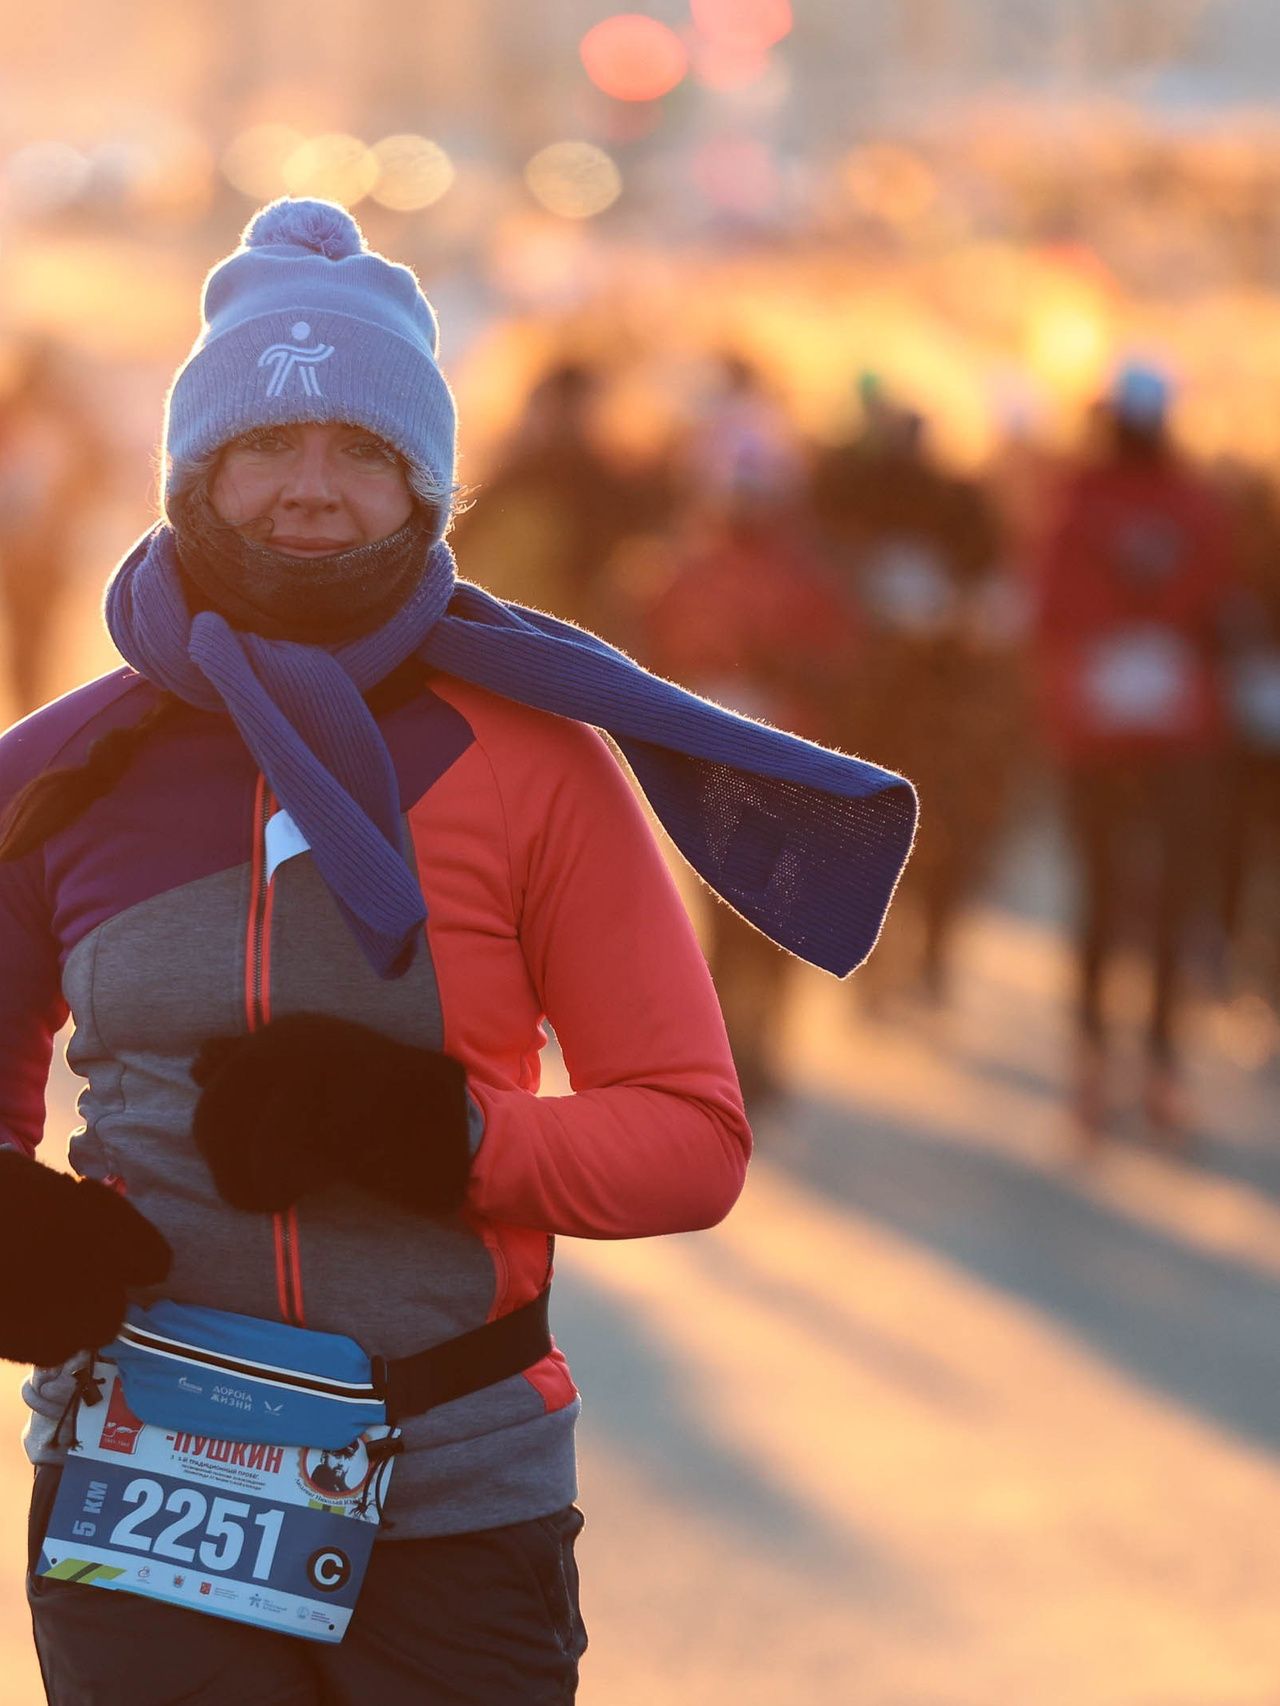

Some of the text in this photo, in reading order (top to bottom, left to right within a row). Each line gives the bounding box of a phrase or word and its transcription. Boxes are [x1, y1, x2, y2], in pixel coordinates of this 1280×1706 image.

[210, 1393, 252, 1411] ЖИЗНИ
[72, 1481, 108, 1537] 5 КМ
[109, 1478, 285, 1581] 2251
